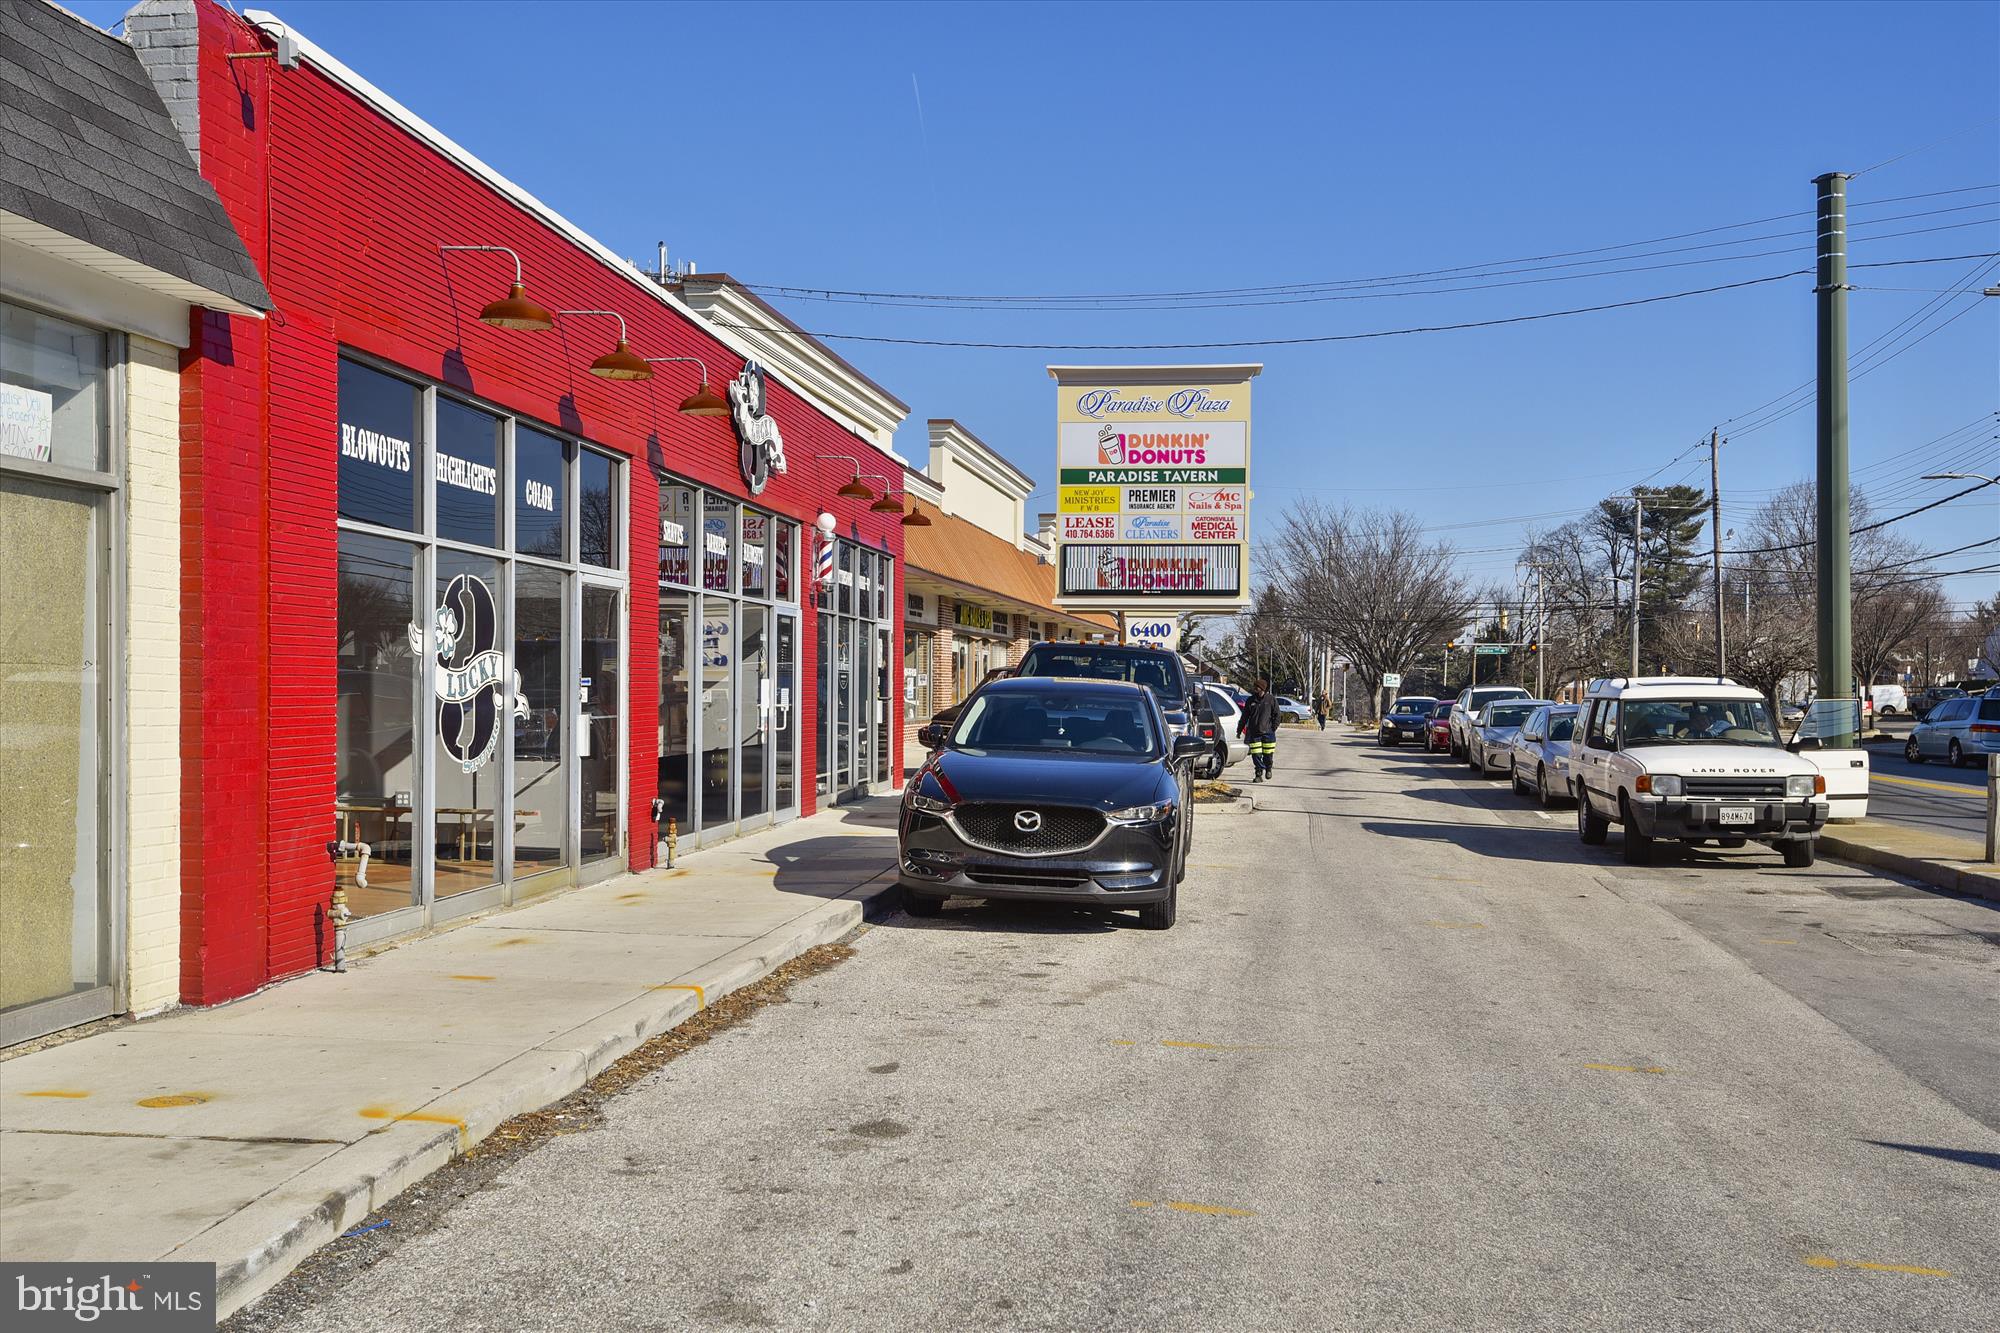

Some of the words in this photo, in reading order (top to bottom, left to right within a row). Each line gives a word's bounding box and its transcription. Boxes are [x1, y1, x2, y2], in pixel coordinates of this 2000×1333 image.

[1076, 388, 1164, 420] Paradise
[1166, 388, 1232, 418] Plaza
[1128, 433, 1210, 448] DUNKIN'
[342, 423, 410, 472] BLOWOUTS
[1128, 450, 1206, 464] DONUTS
[436, 452, 496, 496] HIGHLIGHTS
[1088, 470, 1158, 482] PARADISE
[1163, 470, 1218, 482] TAVERN
[526, 479, 553, 512] COLOR
[1064, 496, 1116, 504] MINISTRIES
[1129, 490, 1176, 502] PREMIER
[1188, 502, 1212, 510] Nails
[1224, 502, 1242, 511] Spa
[1065, 517, 1114, 528] LEASE
[1132, 516, 1170, 528] Paradise
[1191, 522, 1238, 530] MEDICAL
[1065, 529, 1114, 539] 410.764.6366
[1125, 530, 1178, 539] CLEANERS
[1193, 531, 1236, 539] CENTER
[1128, 558, 1208, 572] DUNKIN'
[1128, 573, 1205, 588] DONUTS
[1130, 621, 1172, 638] 6400
[446, 654, 498, 698] LUCKY
[1385, 676, 1393, 684] P
[462, 717, 500, 774] STUDIO
[1721, 812, 1753, 821] 894M674
